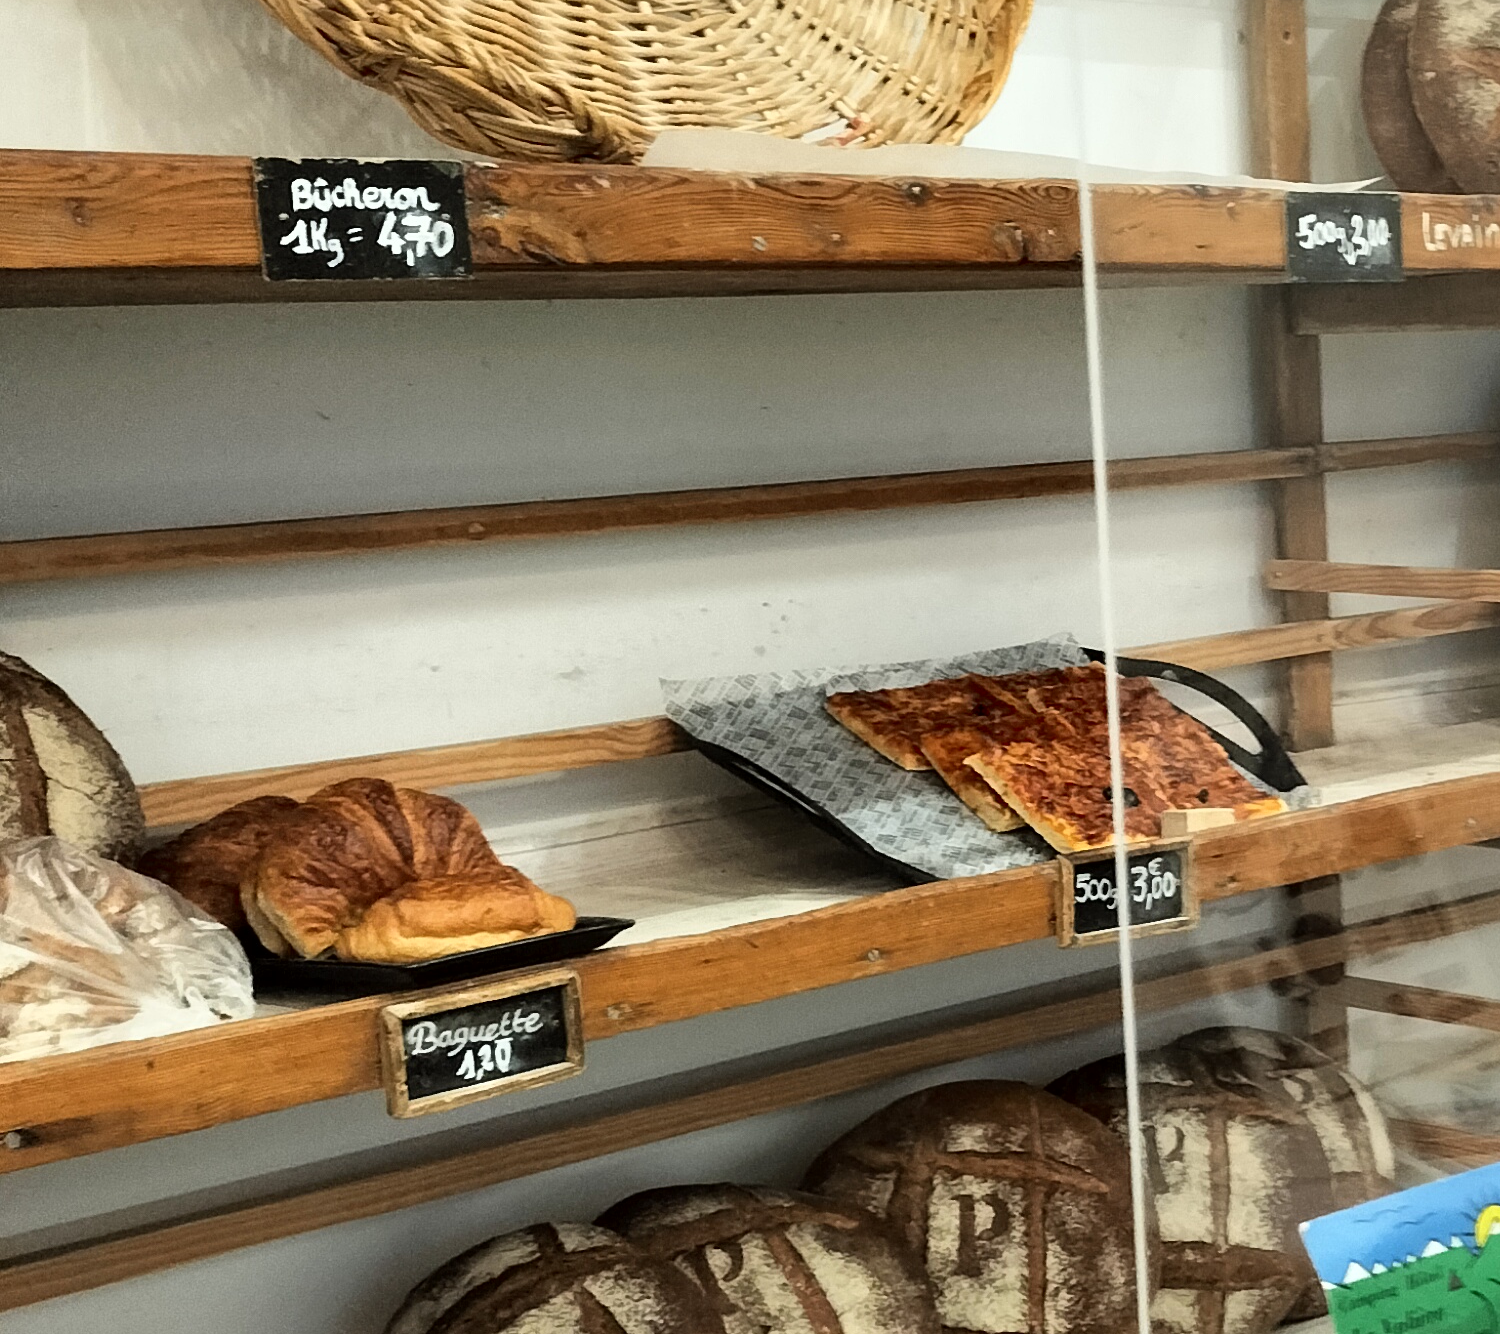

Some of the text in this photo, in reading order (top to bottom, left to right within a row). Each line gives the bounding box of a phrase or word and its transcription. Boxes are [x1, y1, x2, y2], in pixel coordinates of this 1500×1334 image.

[291, 177, 441, 212] Bûcheron
[377, 211, 455, 267] 4,70
[406, 1008, 544, 1057] Baguette
